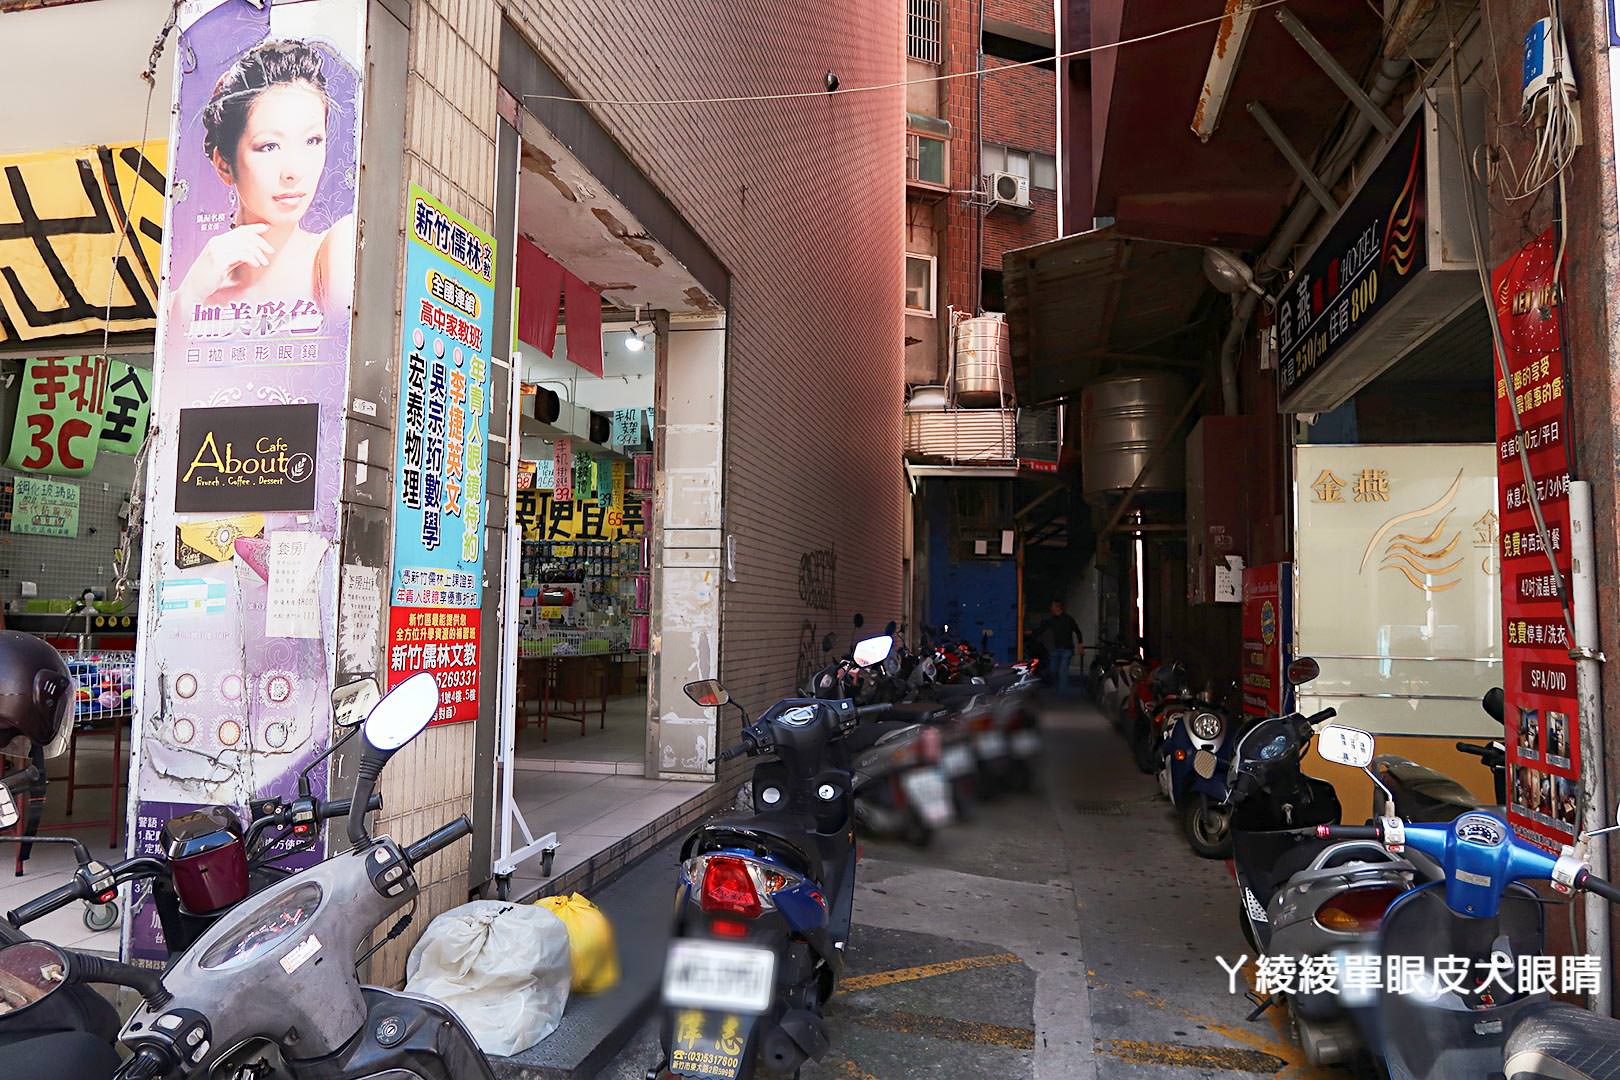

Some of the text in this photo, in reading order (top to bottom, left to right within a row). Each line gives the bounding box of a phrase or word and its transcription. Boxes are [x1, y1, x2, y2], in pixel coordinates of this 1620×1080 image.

[414, 199, 492, 281] 新竹儒林 文教
[1339, 218, 1380, 289] HOTEL
[432, 273, 476, 317] 全國連鎖
[420, 301, 482, 351] 高中家教班
[22, 413, 92, 470] 3C
[256, 437, 288, 454] Cafe
[403, 353, 426, 507] 宏泰物理
[1501, 421, 1559, 459] 住宿80元/平日
[182, 431, 288, 482] About
[228, 476, 250, 486] Coffee
[258, 476, 283, 485] Dessert
[1310, 467, 1391, 504] 金燕
[607, 511, 623, 526] 65
[1508, 621, 1566, 645] 免費停車/洗衣
[391, 642, 477, 671] 新竹儒林文教
[1531, 669, 1567, 691] SPA/DVD
